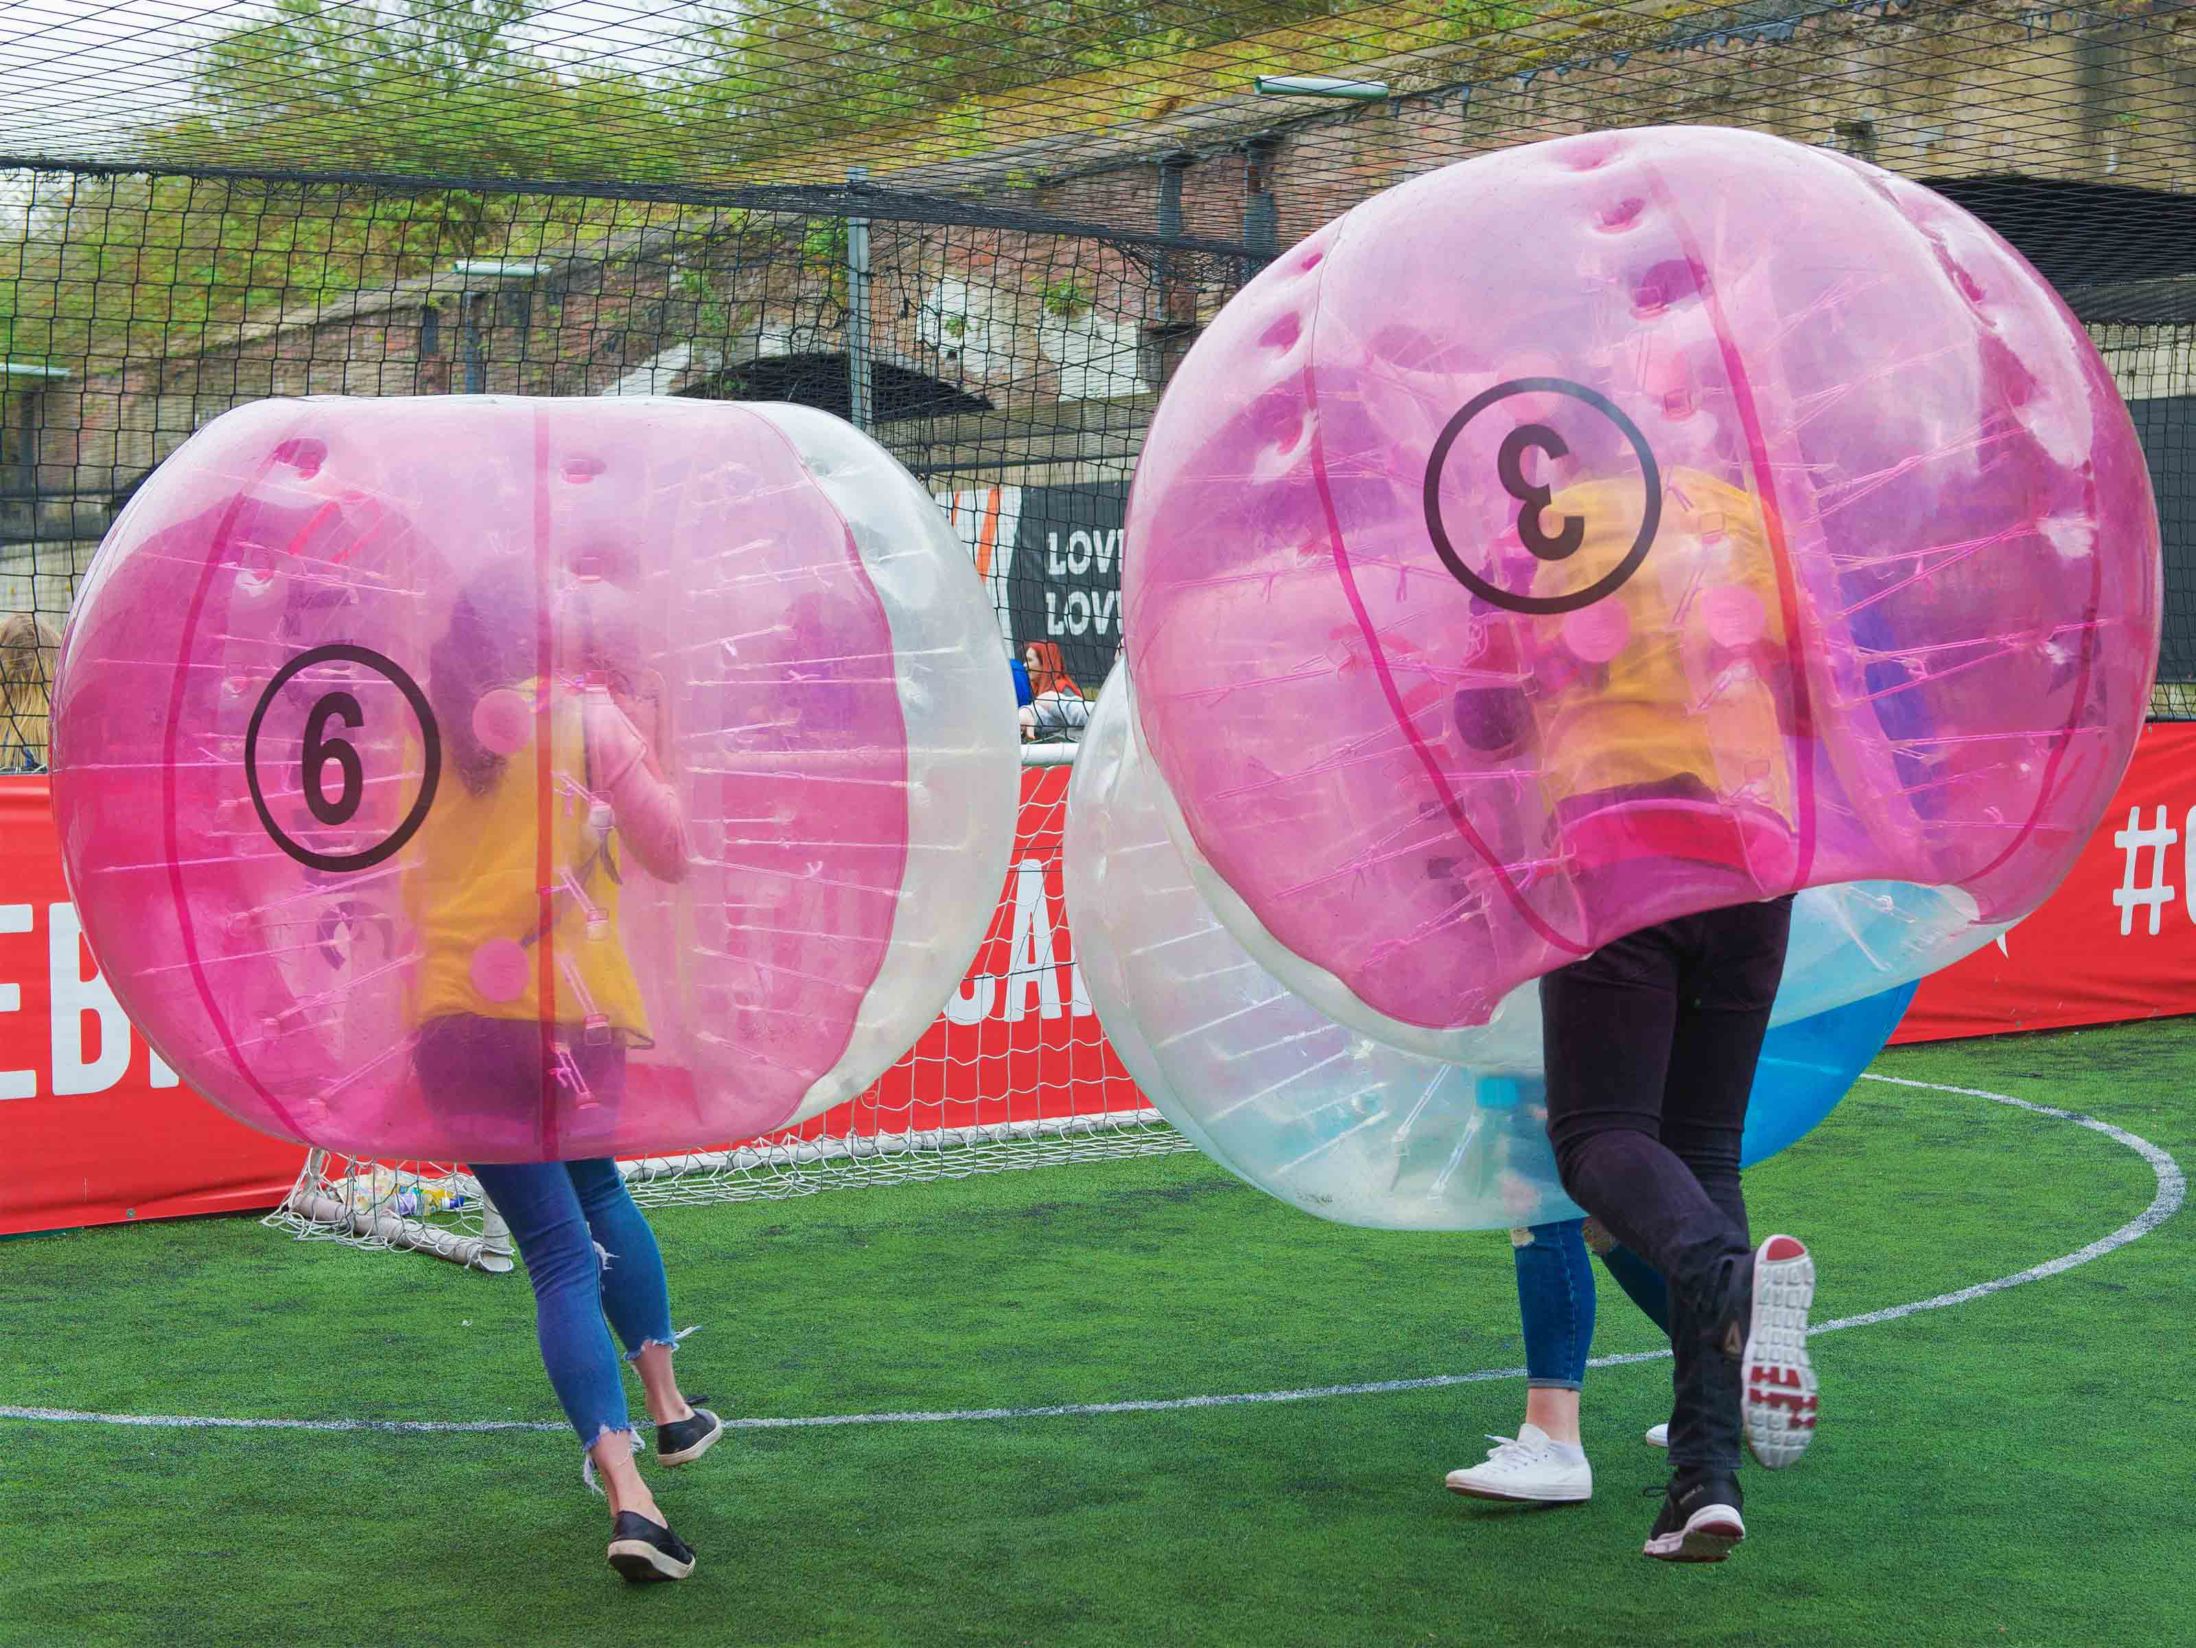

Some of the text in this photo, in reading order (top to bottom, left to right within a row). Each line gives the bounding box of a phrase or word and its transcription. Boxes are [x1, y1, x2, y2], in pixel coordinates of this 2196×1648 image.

[1497, 423, 1585, 561] 3
[302, 691, 364, 826] 6
[0, 902, 180, 1099] EB
